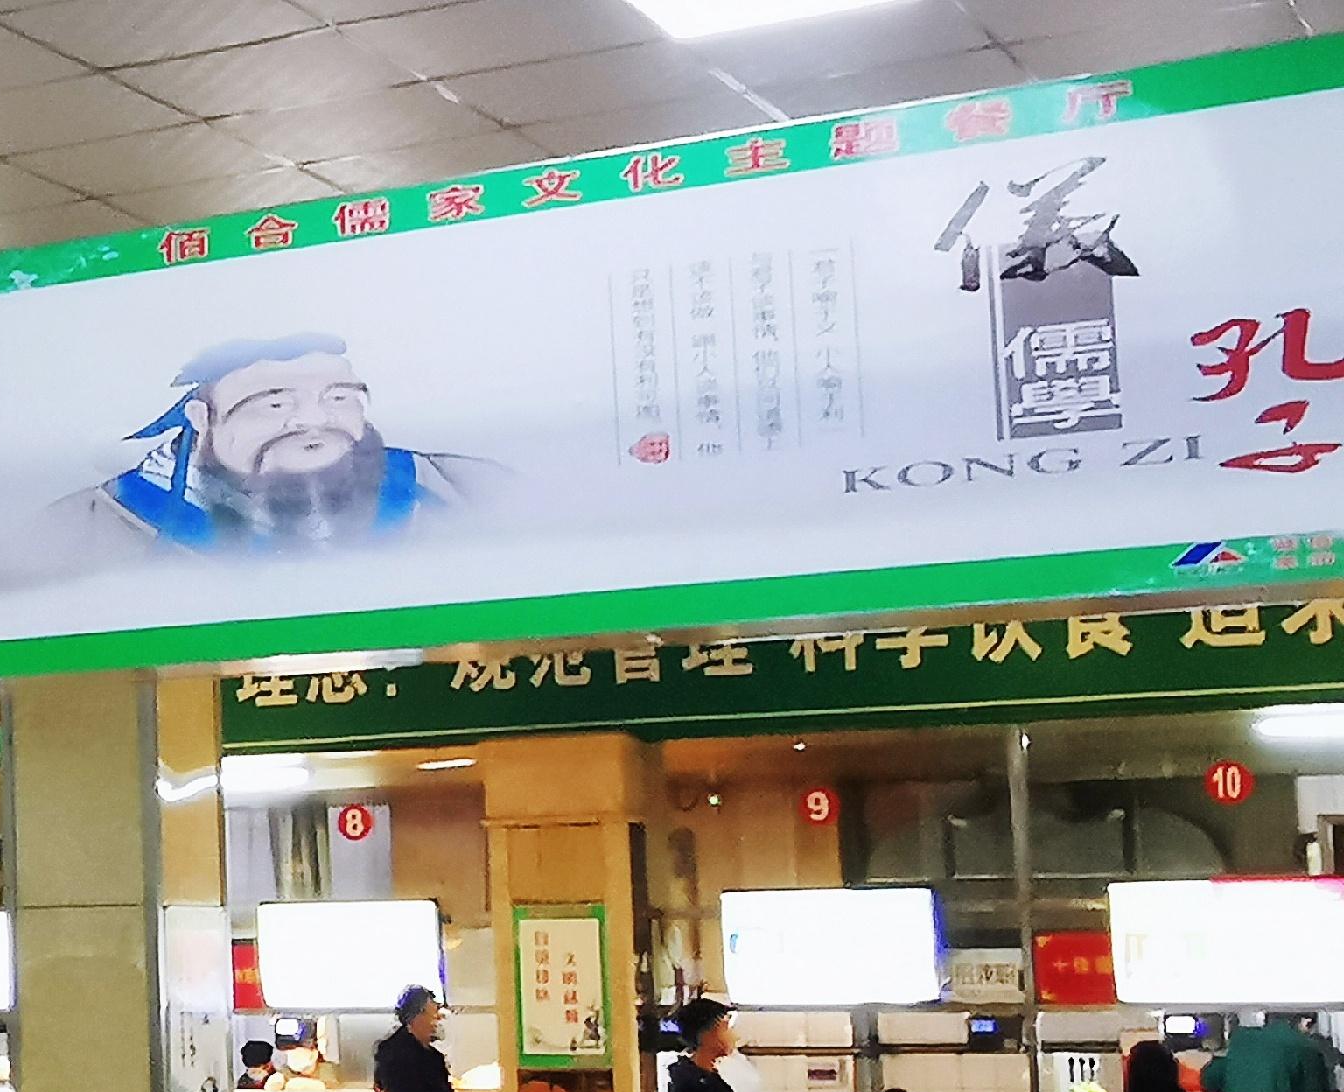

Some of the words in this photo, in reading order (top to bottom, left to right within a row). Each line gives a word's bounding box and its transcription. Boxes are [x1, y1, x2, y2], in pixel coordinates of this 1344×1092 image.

[159, 80, 1132, 264] 佰合儒家文化主题餐厅
[1191, 308, 1344, 473] 孔子
[842, 446, 1083, 494] KONG
[1120, 434, 1206, 468] ZI
[1213, 766, 1242, 798] 10
[345, 808, 365, 837] 8
[807, 791, 829, 821] 9
